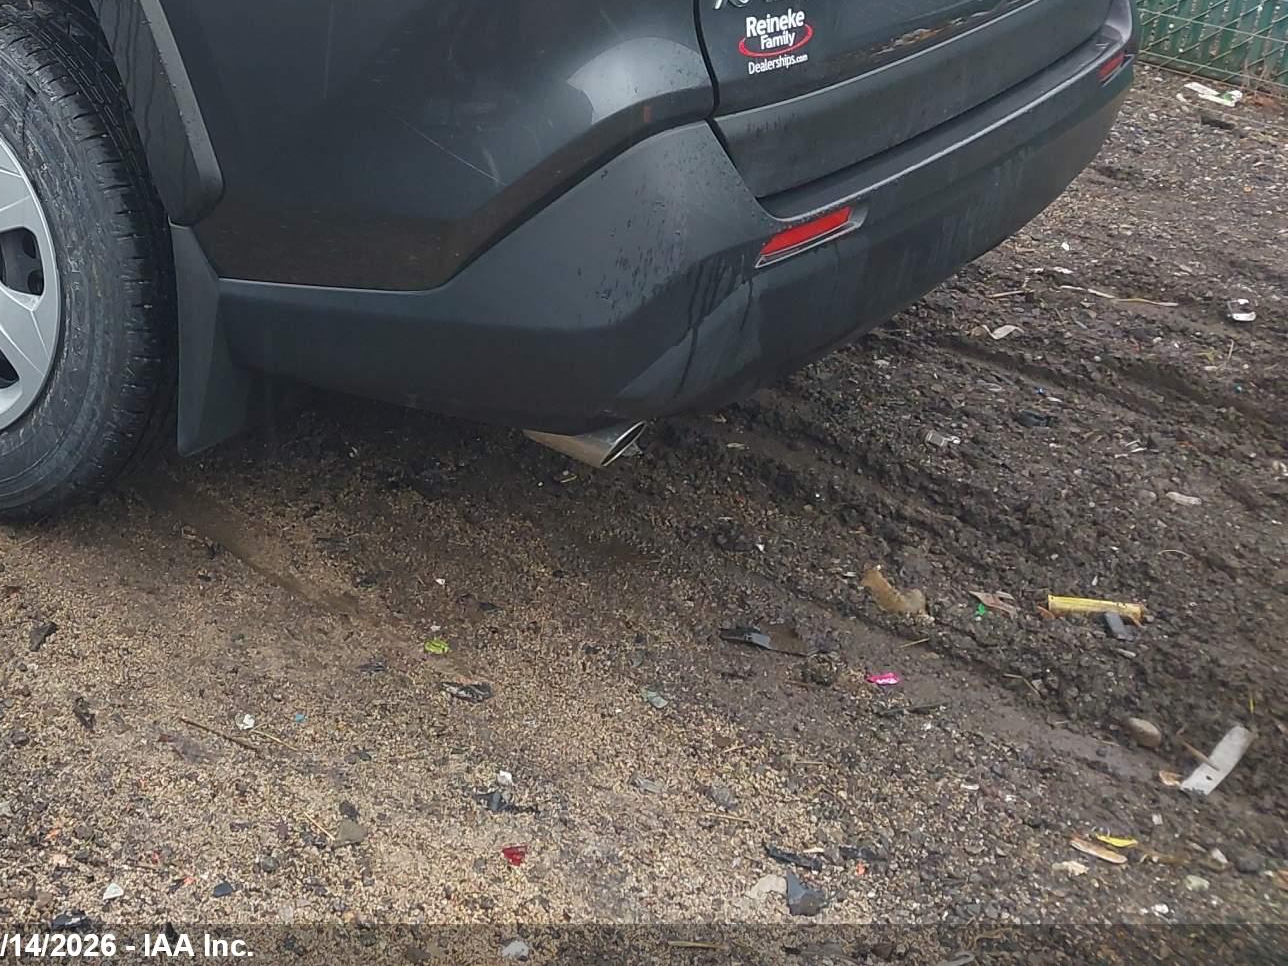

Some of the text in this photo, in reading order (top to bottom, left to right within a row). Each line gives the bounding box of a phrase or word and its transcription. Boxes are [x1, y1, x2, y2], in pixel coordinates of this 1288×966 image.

[745, 8, 806, 37] Reineke
[760, 30, 796, 50] Family
[748, 54, 808, 75] Dealerships.com
